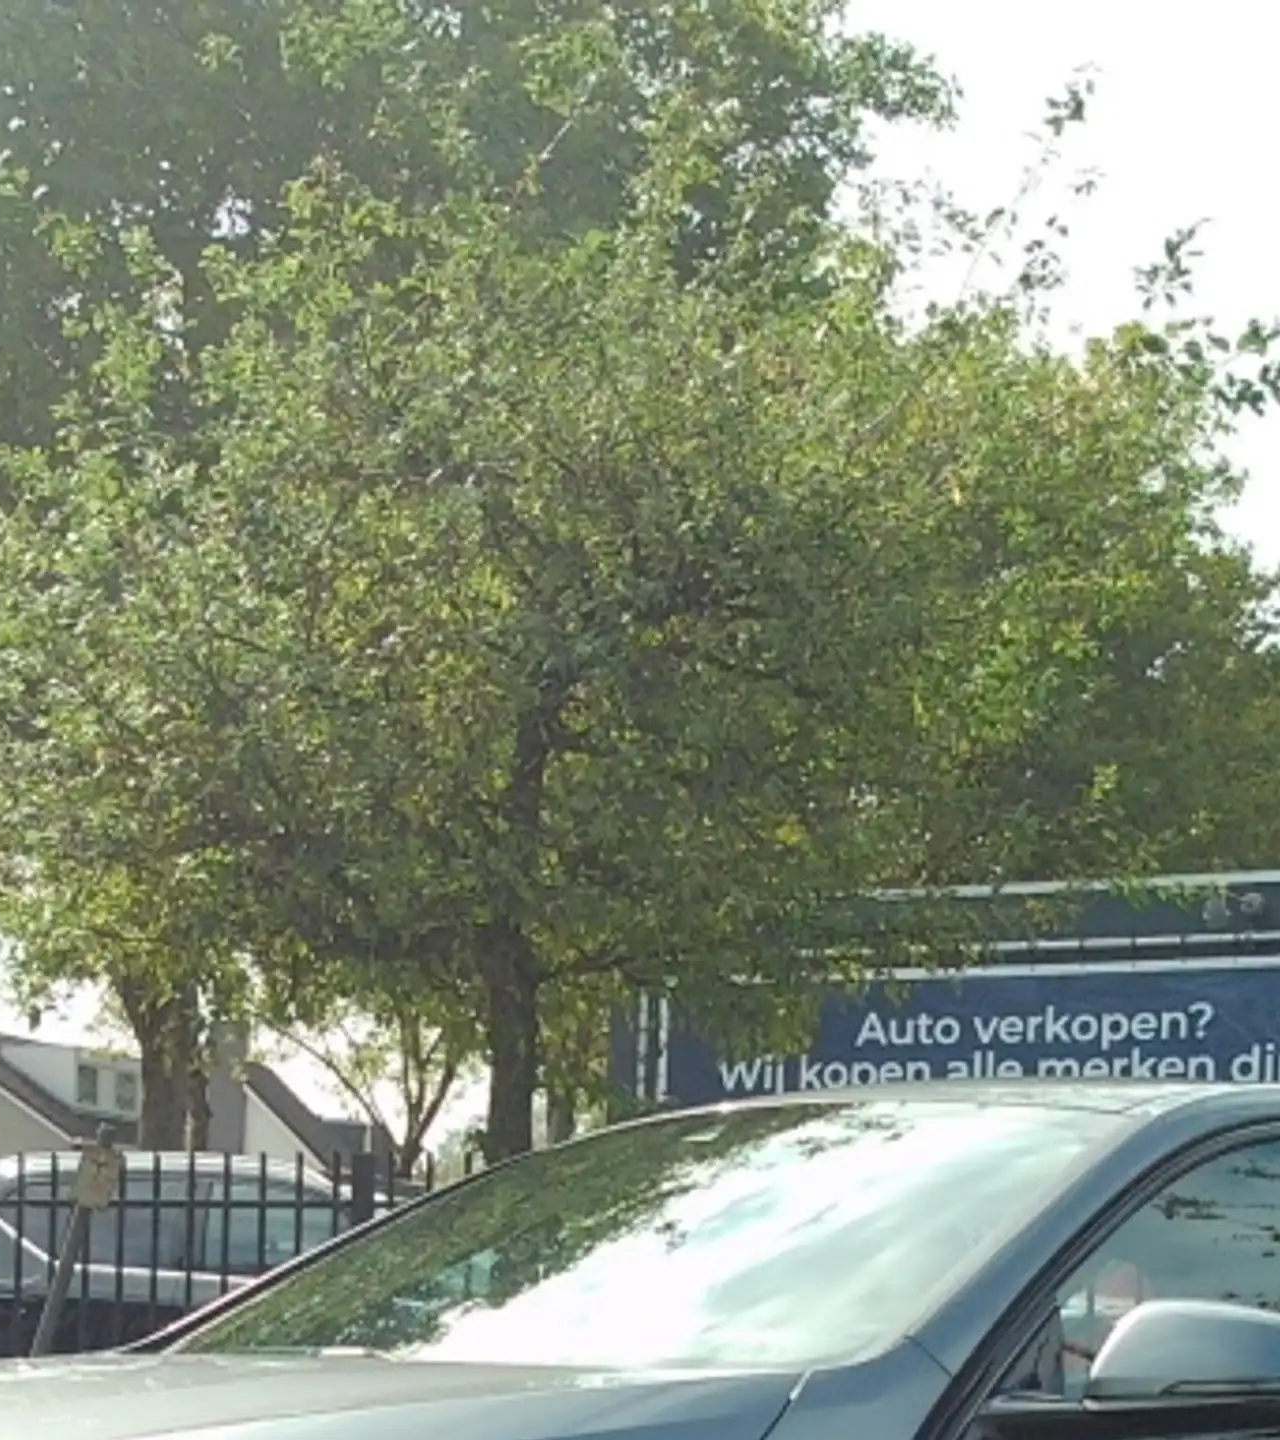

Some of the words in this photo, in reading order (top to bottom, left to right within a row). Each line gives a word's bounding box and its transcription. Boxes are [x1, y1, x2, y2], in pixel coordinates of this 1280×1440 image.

[854, 1011, 961, 1048] Auto
[972, 1001, 1216, 1051] verkopen?
[946, 1049, 1024, 1080] alle
[1037, 1046, 1216, 1081] merken
